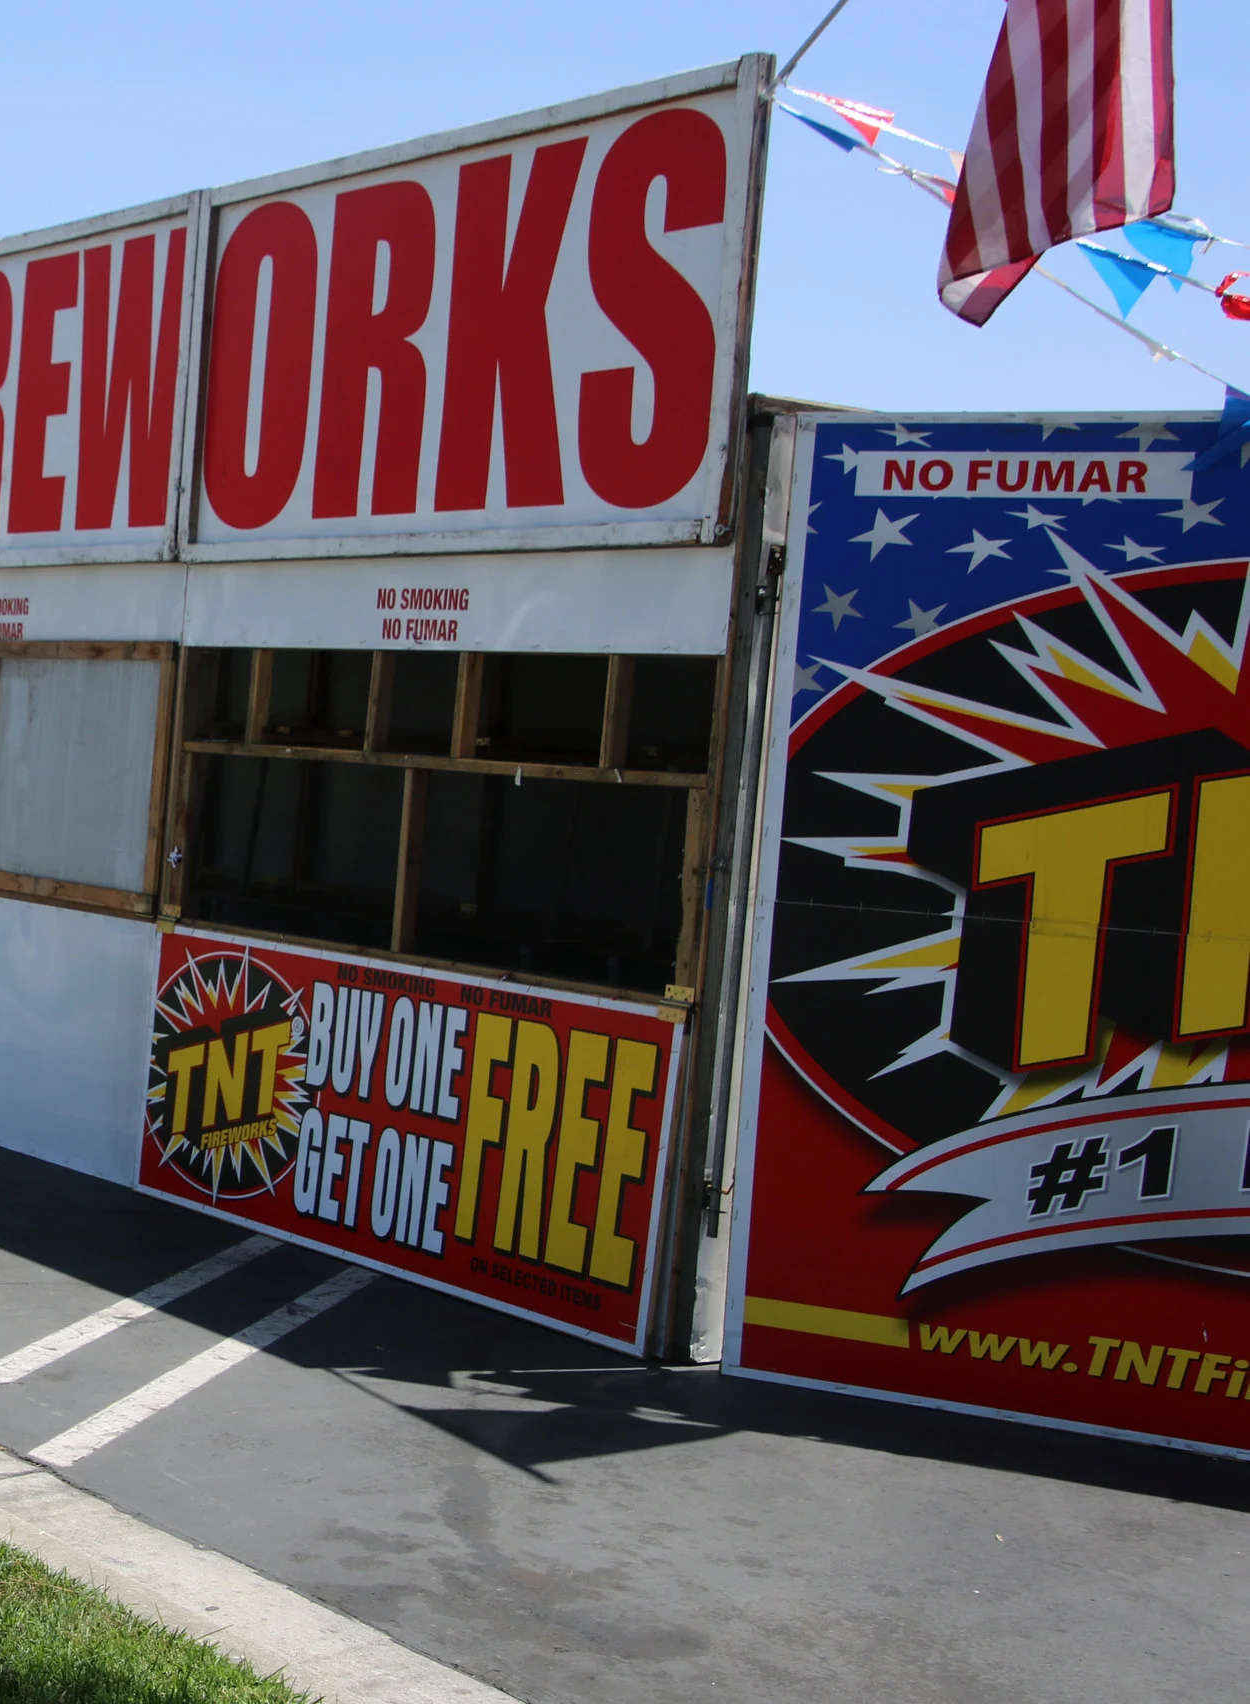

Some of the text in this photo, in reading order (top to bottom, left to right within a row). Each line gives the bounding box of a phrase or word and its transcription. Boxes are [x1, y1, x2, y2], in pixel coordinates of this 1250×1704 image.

[882, 458, 1149, 494] NO FUMAR
[376, 588, 469, 611] NO SMOKING
[382, 618, 458, 642] NO FUMAR
[337, 963, 552, 1018] NO SMOKING NO FUMAR
[166, 1018, 294, 1135] TNT
[305, 979, 469, 1121] BUY ONE
[200, 1118, 278, 1151] FIREWORKS
[454, 1011, 659, 1291] FREE
[293, 1107, 454, 1256] GET ONE
[1027, 1123, 1181, 1221] #1
[470, 1256, 601, 1312] ON SELECTED ITEMS
[918, 1322, 1250, 1400] www.TNTFi
